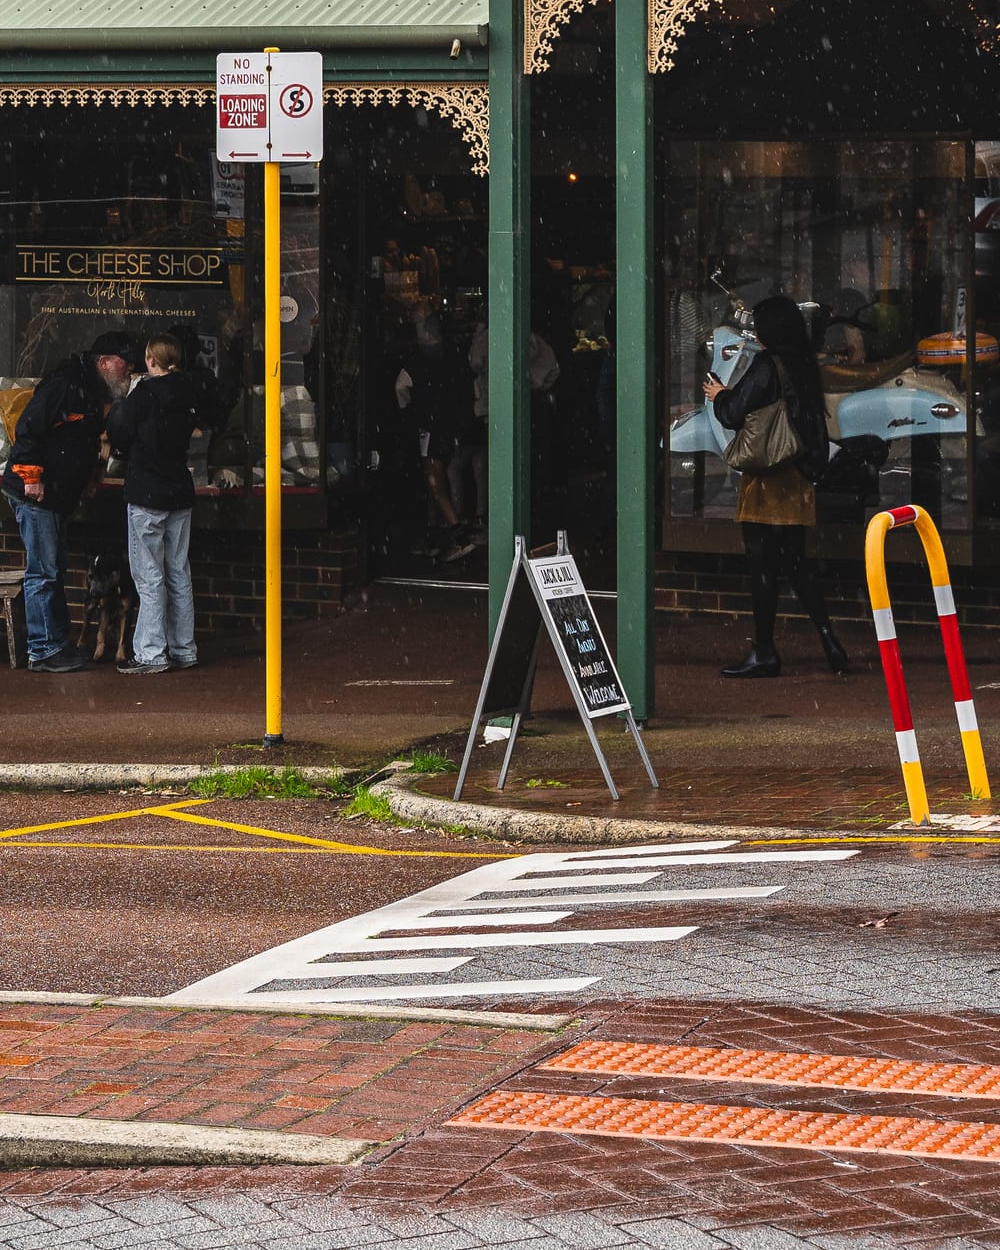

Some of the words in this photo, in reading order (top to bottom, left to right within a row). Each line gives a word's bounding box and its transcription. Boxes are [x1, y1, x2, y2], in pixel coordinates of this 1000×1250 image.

[233, 58, 250, 70] NO
[220, 73, 265, 85] STANDING
[221, 98, 265, 113] LOADING
[227, 113, 258, 126] ZONE
[18, 252, 60, 274] THE
[66, 252, 152, 275] CHEESE
[158, 254, 220, 277] SHOP
[58, 307, 100, 315] AUSTRALIAN
[109, 308, 163, 316] INTERNATIONAL
[166, 309, 196, 317] CHEESES
[540, 567, 558, 585] JACK
[560, 566, 574, 581] JILL
